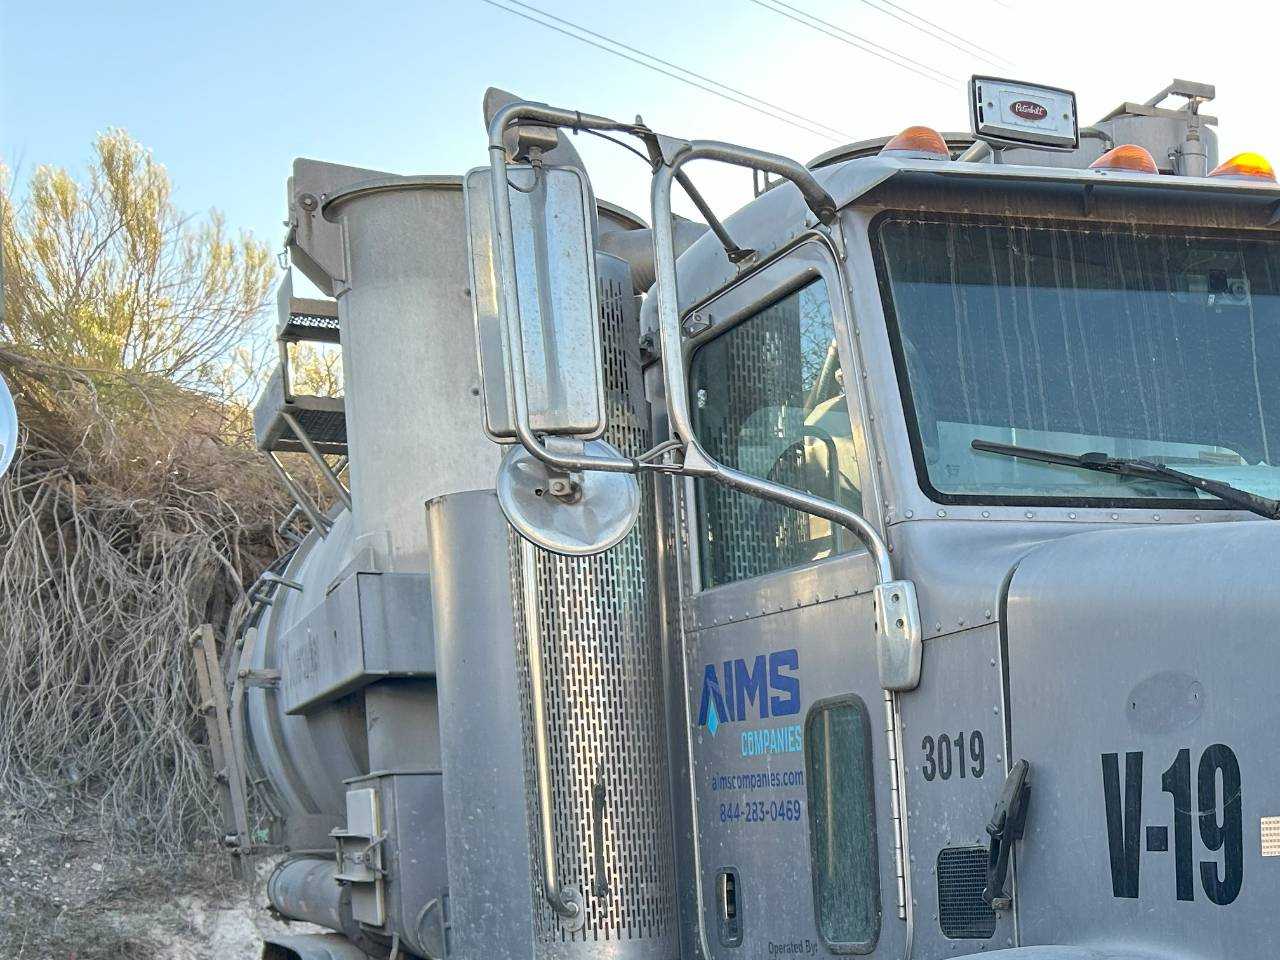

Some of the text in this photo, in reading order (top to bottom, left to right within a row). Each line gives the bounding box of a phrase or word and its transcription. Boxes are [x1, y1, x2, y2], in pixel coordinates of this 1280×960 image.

[698, 648, 801, 726] AIMS
[741, 724, 803, 757] COMPANIES
[921, 730, 985, 782] 3019
[711, 769, 804, 791] aimscompanies.com
[720, 799, 802, 823] 844-283-0469
[1101, 743, 1244, 906] V-19
[768, 941, 804, 959] Operated
